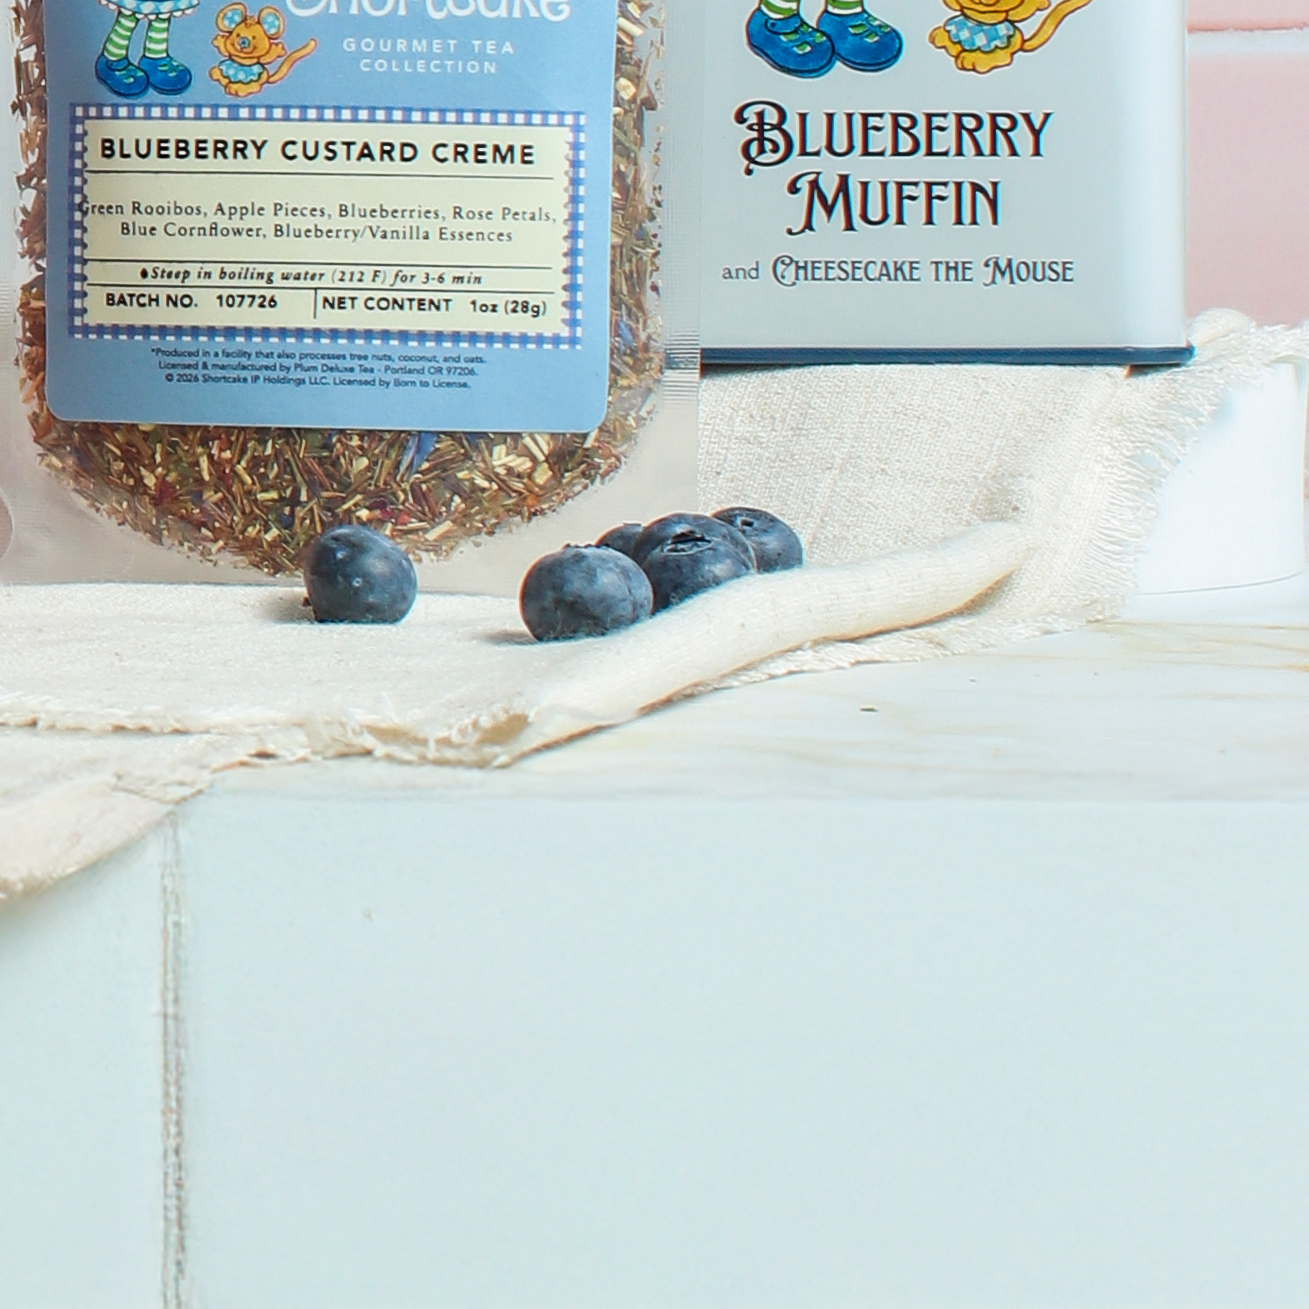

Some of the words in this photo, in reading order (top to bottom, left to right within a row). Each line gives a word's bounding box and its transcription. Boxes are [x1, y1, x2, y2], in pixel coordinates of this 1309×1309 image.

[343, 39, 459, 54] GOURMET
[473, 41, 514, 54] TEA
[360, 60, 498, 74] COLLECTION
[101, 139, 268, 159] BLUEBERRY
[281, 140, 418, 163] CUSTARD
[432, 143, 535, 165] CREME
[78, 200, 125, 215] Green
[132, 201, 207, 217] Rooibos,
[214, 203, 265, 220] Apple
[273, 203, 332, 219] Pieces,
[339, 203, 446, 221] Blueberries,
[453, 206, 493, 220] Rose
[502, 207, 557, 223] Petals,
[121, 223, 157, 235] Blue
[164, 223, 267, 239] Cornflower,
[273, 224, 430, 243] Blueberry/Vanilla
[439, 228, 513, 241] Essences
[151, 267, 191, 283] Steep
[197, 267, 212, 279] in
[219, 267, 274, 283] boiling
[281, 271, 325, 281] water
[331, 268, 365, 283] (212
[371, 269, 387, 283] F)
[390, 270, 417, 287] for
[421, 272, 445, 283] 3-6
[451, 272, 483, 285] min
[722, 262, 760, 280] and
[105, 293, 160, 307] BATCH
[166, 295, 198, 307] NO.
[217, 295, 277, 307] 107726
[323, 297, 358, 310] NET
[363, 297, 453, 311] CONTENT
[470, 299, 499, 313] 1oz
[504, 300, 547, 317] (28g)
